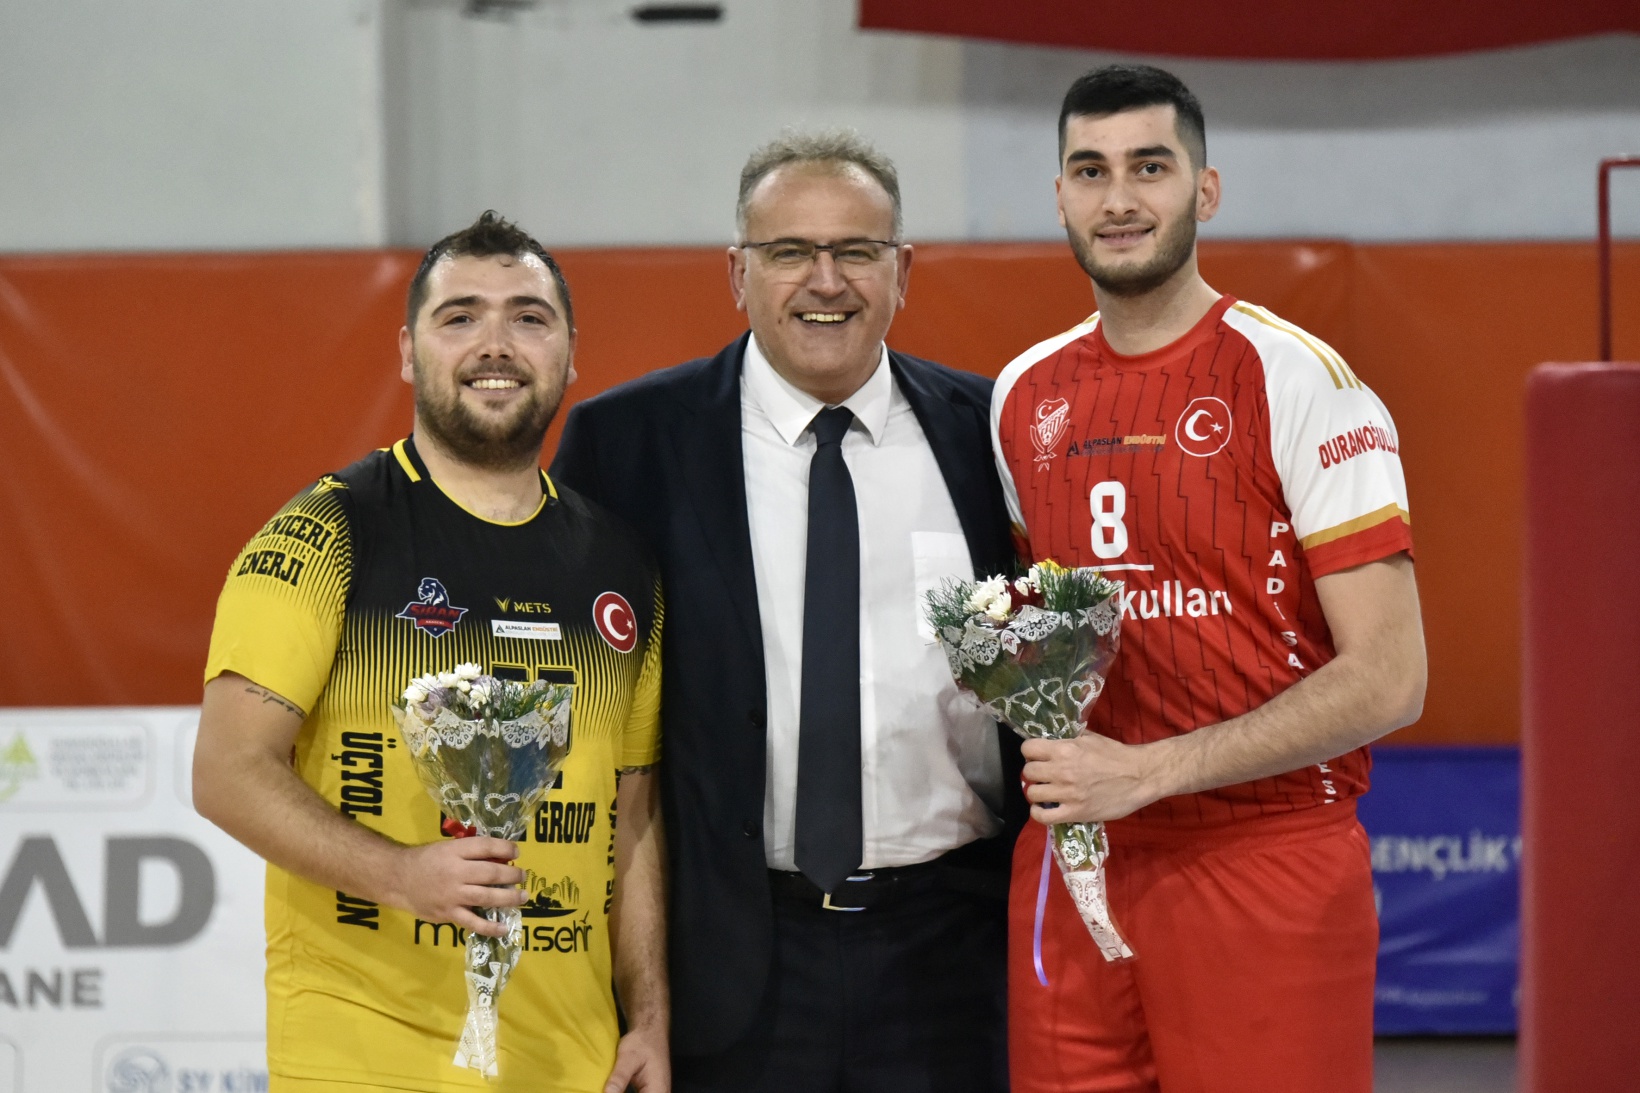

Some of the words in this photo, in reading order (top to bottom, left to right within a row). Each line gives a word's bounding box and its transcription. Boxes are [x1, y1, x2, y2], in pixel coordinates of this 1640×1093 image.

[1317, 419, 1397, 470] DURANOĞULL
[258, 507, 336, 553] ENİÇERİ
[1089, 480, 1129, 560] 8
[236, 549, 306, 587] ENERJİ
[513, 601, 552, 614] METS
[1119, 580, 1232, 620] kulları
[331, 731, 397, 821] ÜÇYOL
[535, 801, 596, 844] GROUP
[1371, 828, 1510, 881] ENÇLİK
